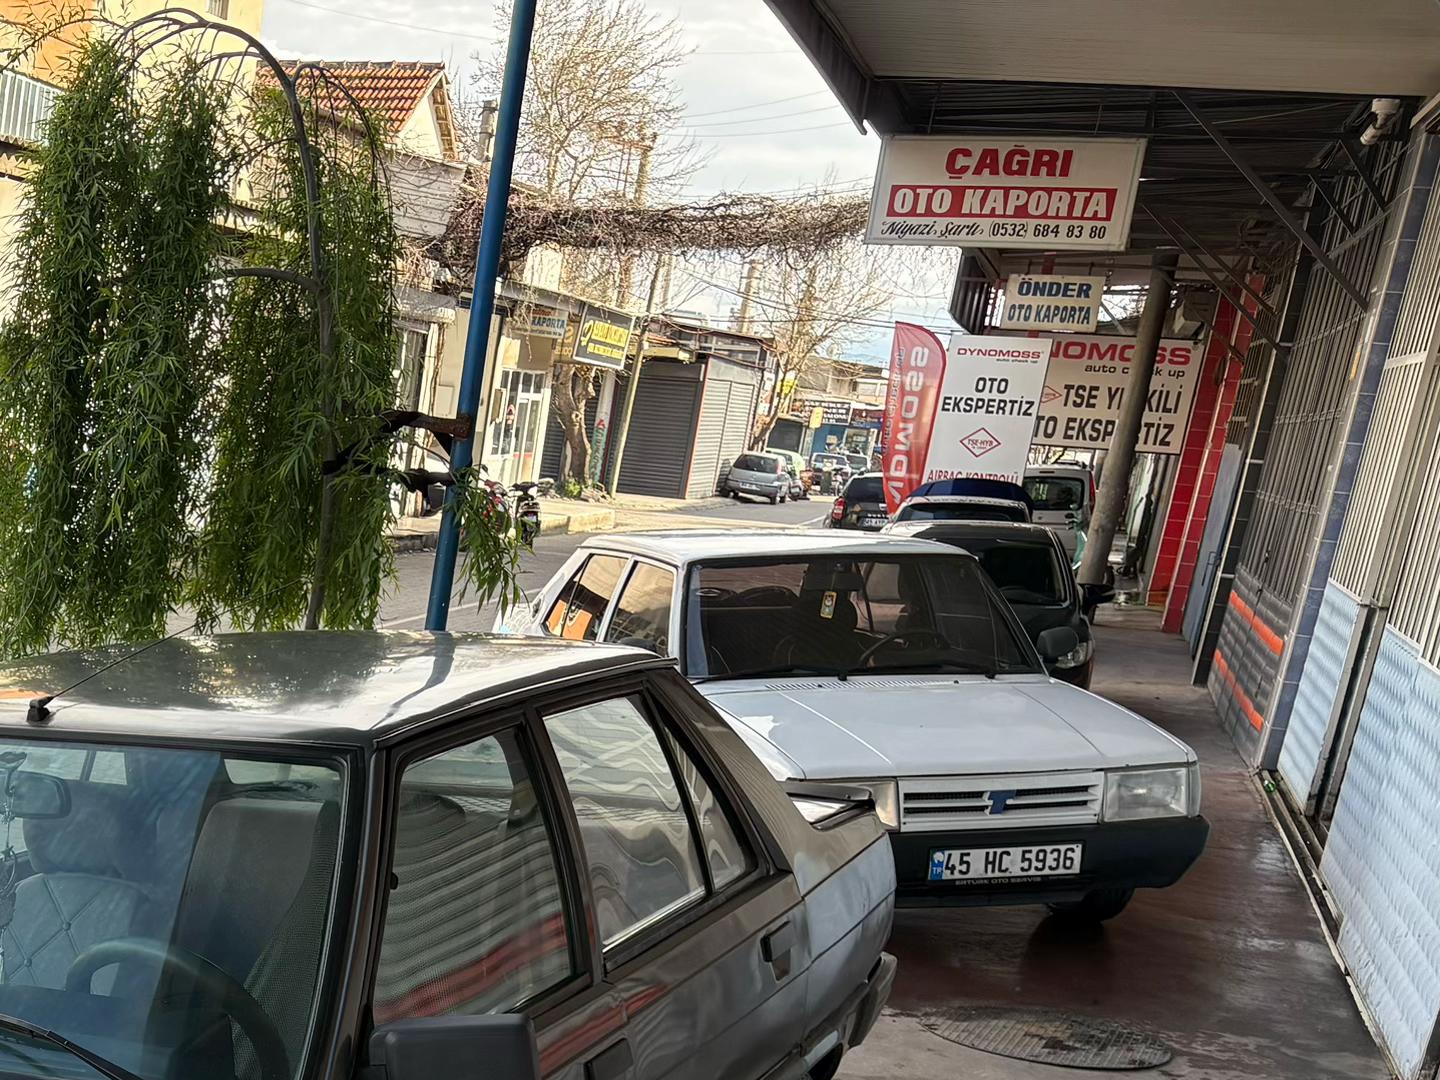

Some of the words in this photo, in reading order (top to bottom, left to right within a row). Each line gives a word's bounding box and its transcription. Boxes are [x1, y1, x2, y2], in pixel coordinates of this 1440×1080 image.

[945, 145, 1073, 179] ÇAĞRI
[893, 188, 952, 214] OTO
[961, 189, 1108, 218] KAPORTA
[881, 221, 937, 239] Niyazi
[989, 221, 1029, 239] (0532)
[1033, 223, 1060, 238] 684
[1066, 224, 1083, 239] 83
[1089, 225, 1107, 239] 80
[1018, 278, 1092, 299] ÖNDER
[1008, 304, 1032, 322] OTO
[1034, 304, 1091, 325] KAPORTA
[957, 348, 1041, 359] DYNOMOSS
[1084, 364, 1116, 374] auto
[1168, 368, 1186, 380] up
[975, 377, 1009, 394] OTO
[941, 396, 1035, 416] EKSPERTİZ
[1063, 384, 1100, 409] TSE
[1108, 384, 1183, 414] YKİLİ
[1034, 416, 1058, 439] TO
[1063, 416, 1175, 447] EKSPTİZ
[945, 852, 971, 875] 45
[984, 850, 1011, 874] HC
[1020, 847, 1076, 872] 5936
